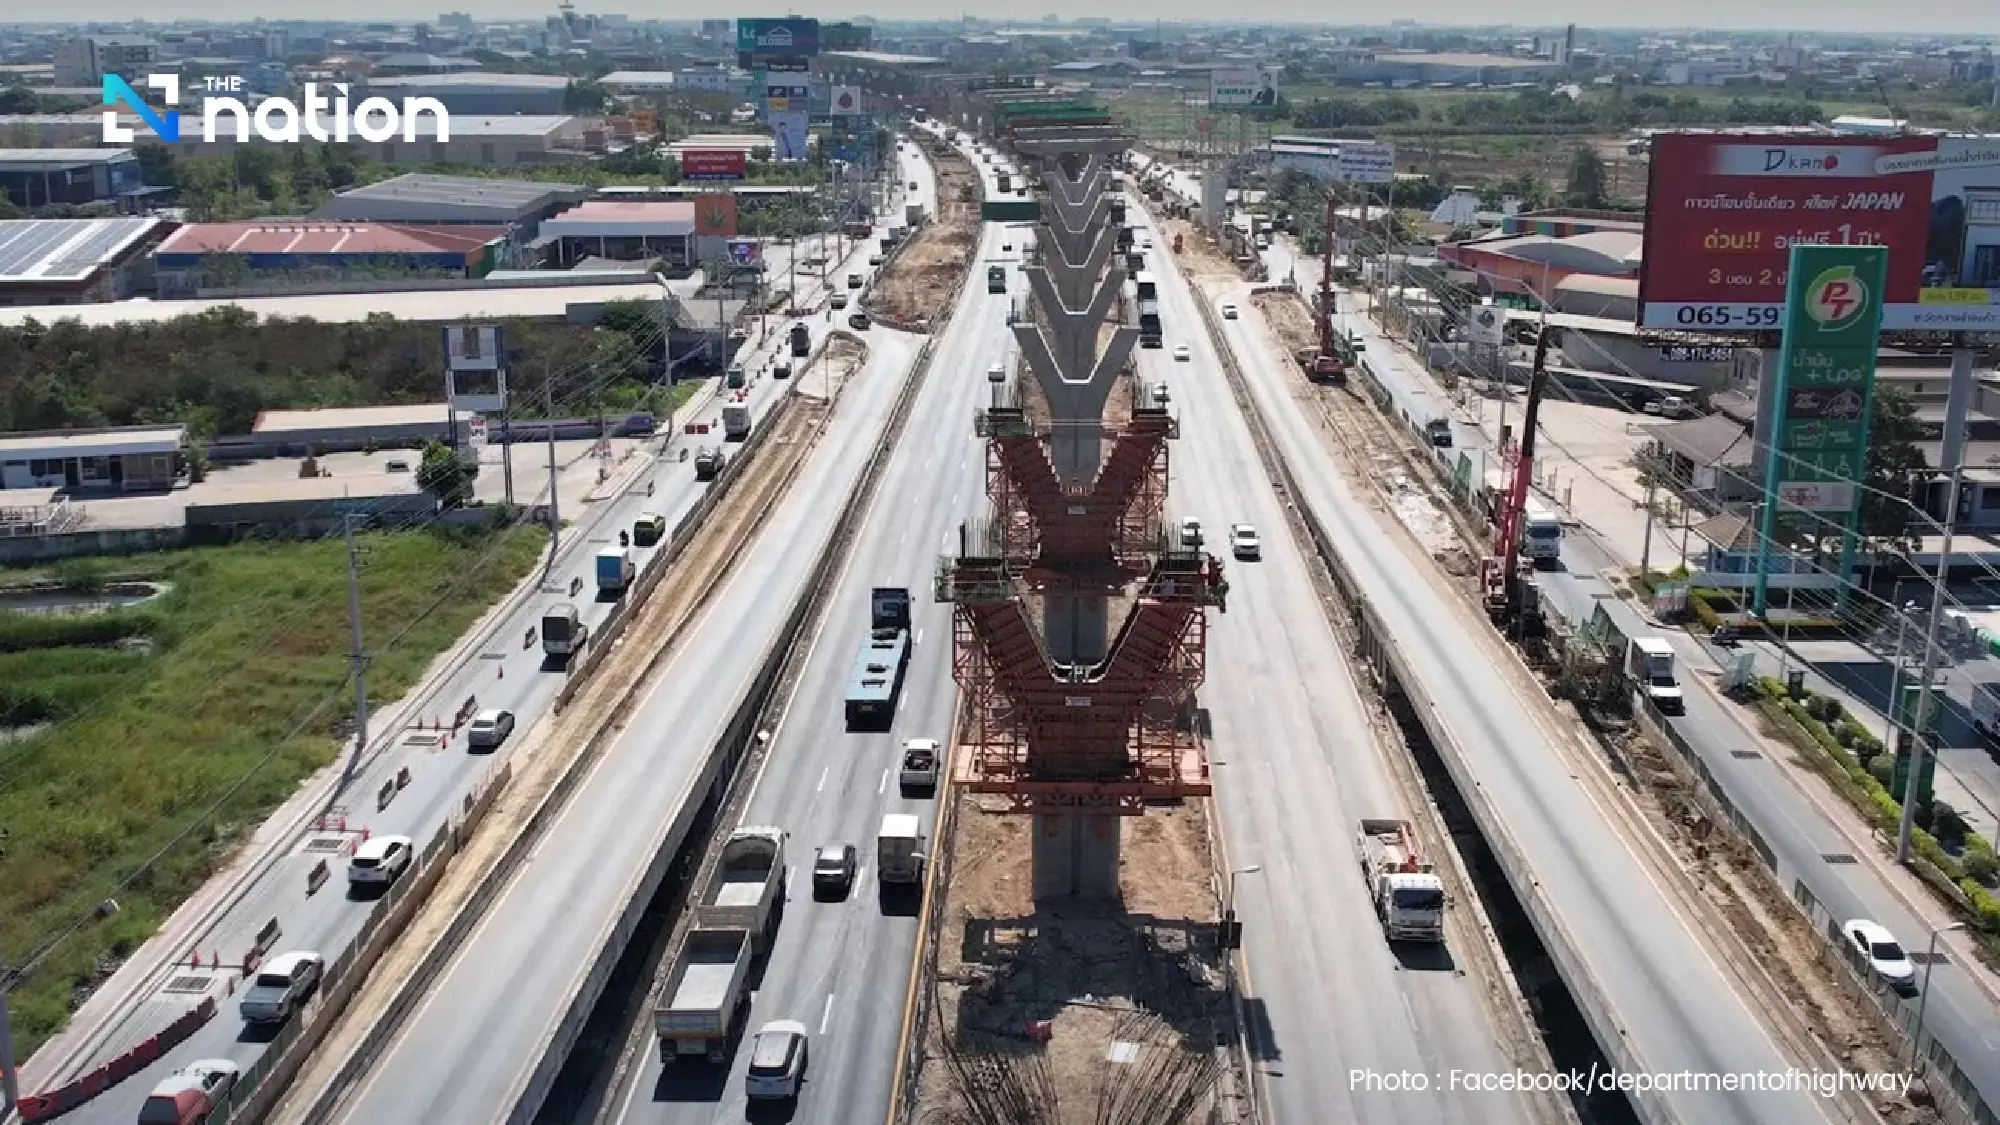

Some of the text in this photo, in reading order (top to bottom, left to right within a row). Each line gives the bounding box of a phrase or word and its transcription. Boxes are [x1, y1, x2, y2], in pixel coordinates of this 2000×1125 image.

[1684, 192, 1795, 210] ทาวน์โฮมชั้นเดียว
[1842, 192, 1905, 210] JAPAN
[1704, 228, 1761, 249] ด่วน!!
[1837, 223, 1852, 245] 1
[1708, 268, 1721, 284] 3
[1759, 268, 1772, 284] 2
[1821, 281, 1855, 319] PT
[1677, 305, 1786, 326] 065-59
